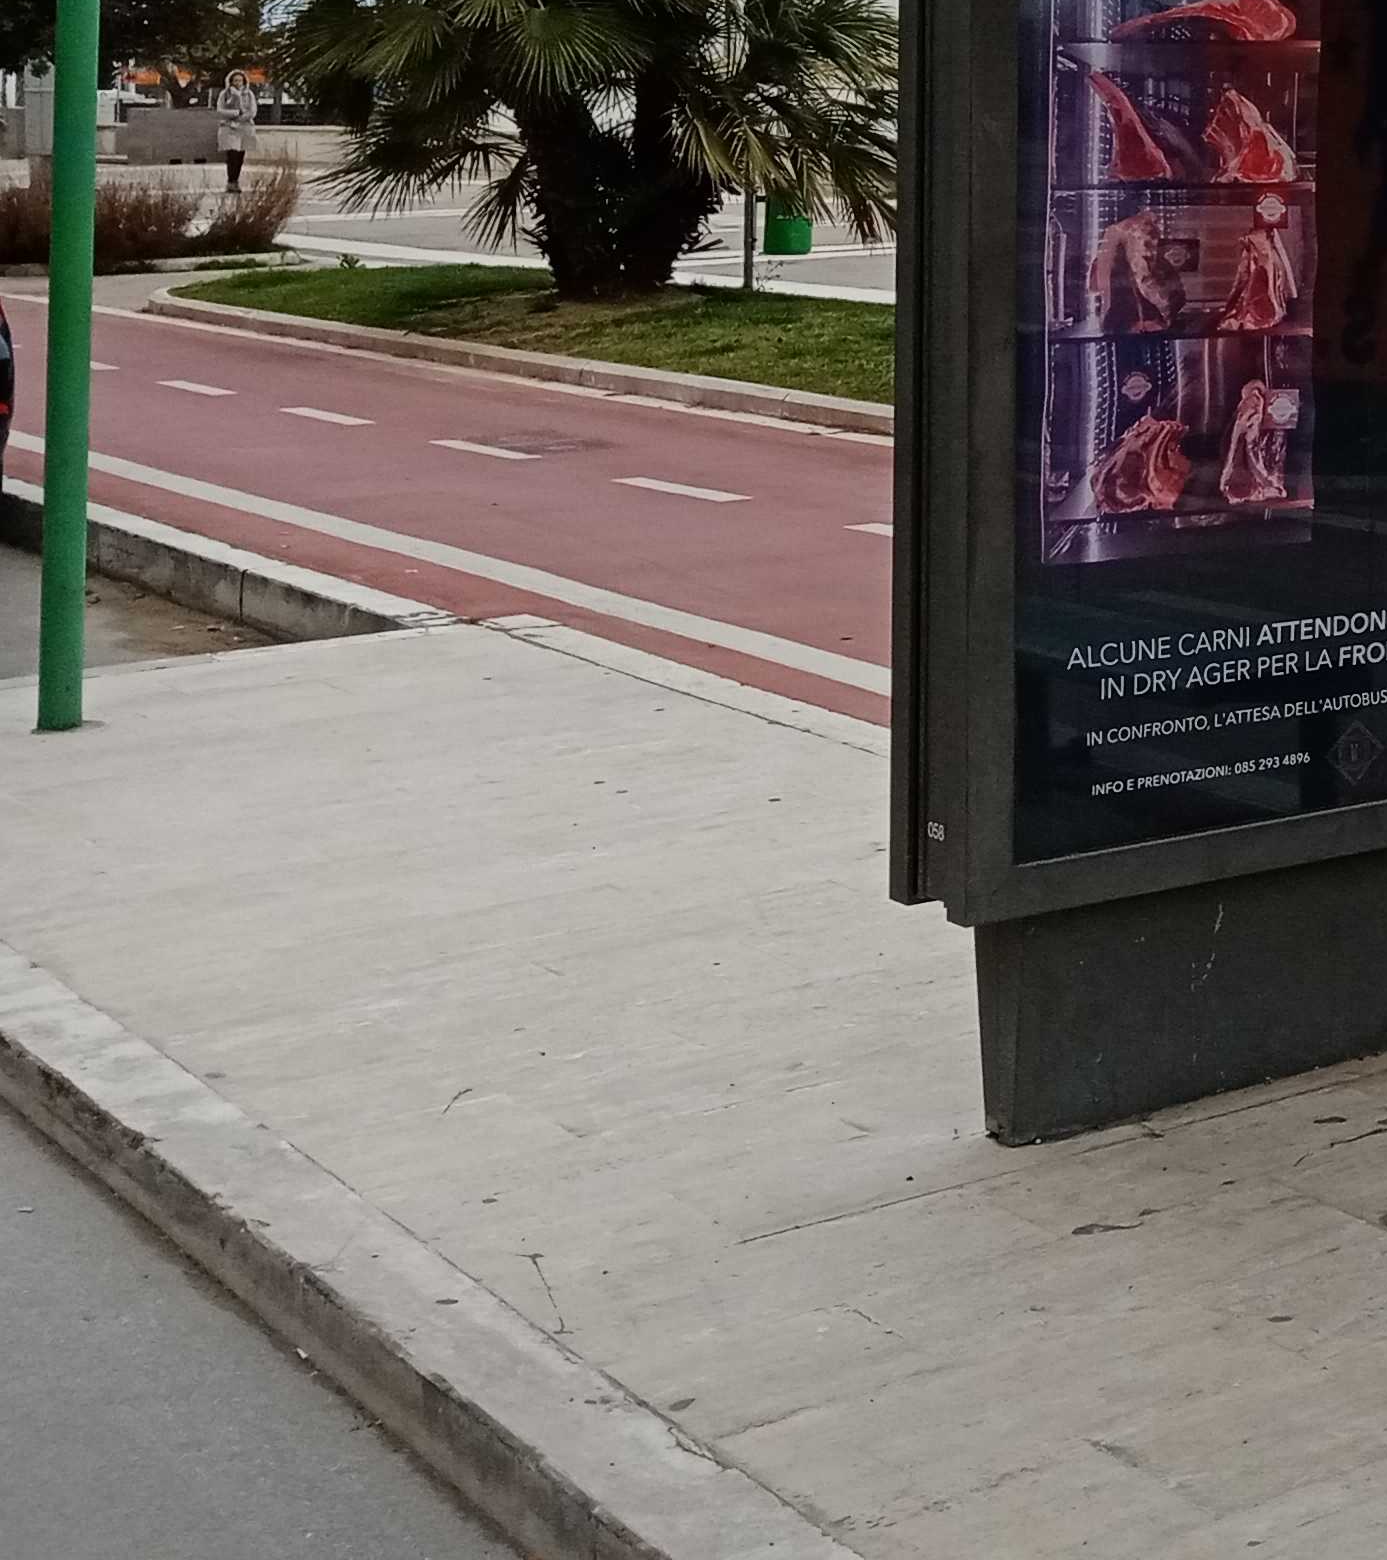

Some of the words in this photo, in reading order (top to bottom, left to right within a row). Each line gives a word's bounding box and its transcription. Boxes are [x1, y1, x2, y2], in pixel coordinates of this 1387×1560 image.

[1067, 636, 1171, 670] ALCUNE
[1178, 626, 1250, 656] CARNI
[1100, 675, 1125, 700] IN
[1133, 668, 1182, 696] DRY
[1186, 659, 1250, 689] AGER
[1257, 652, 1298, 679] PER
[1305, 648, 1332, 672] LA
[1086, 730, 1103, 746] IN
[1107, 714, 1211, 744] CONFRONTO,
[1214, 705, 1280, 728] L'ATTESA
[1285, 689, 1387, 717] DELL'AUTOBUS
[1091, 780, 1123, 796] INFO
[1127, 778, 1135, 791] E
[1137, 765, 1232, 789] PRENOTAZIONI:
[1234, 759, 1255, 774] 085
[1258, 755, 1280, 771] 293
[1282, 752, 1310, 768] 4896
[927, 821, 945, 841] 058
